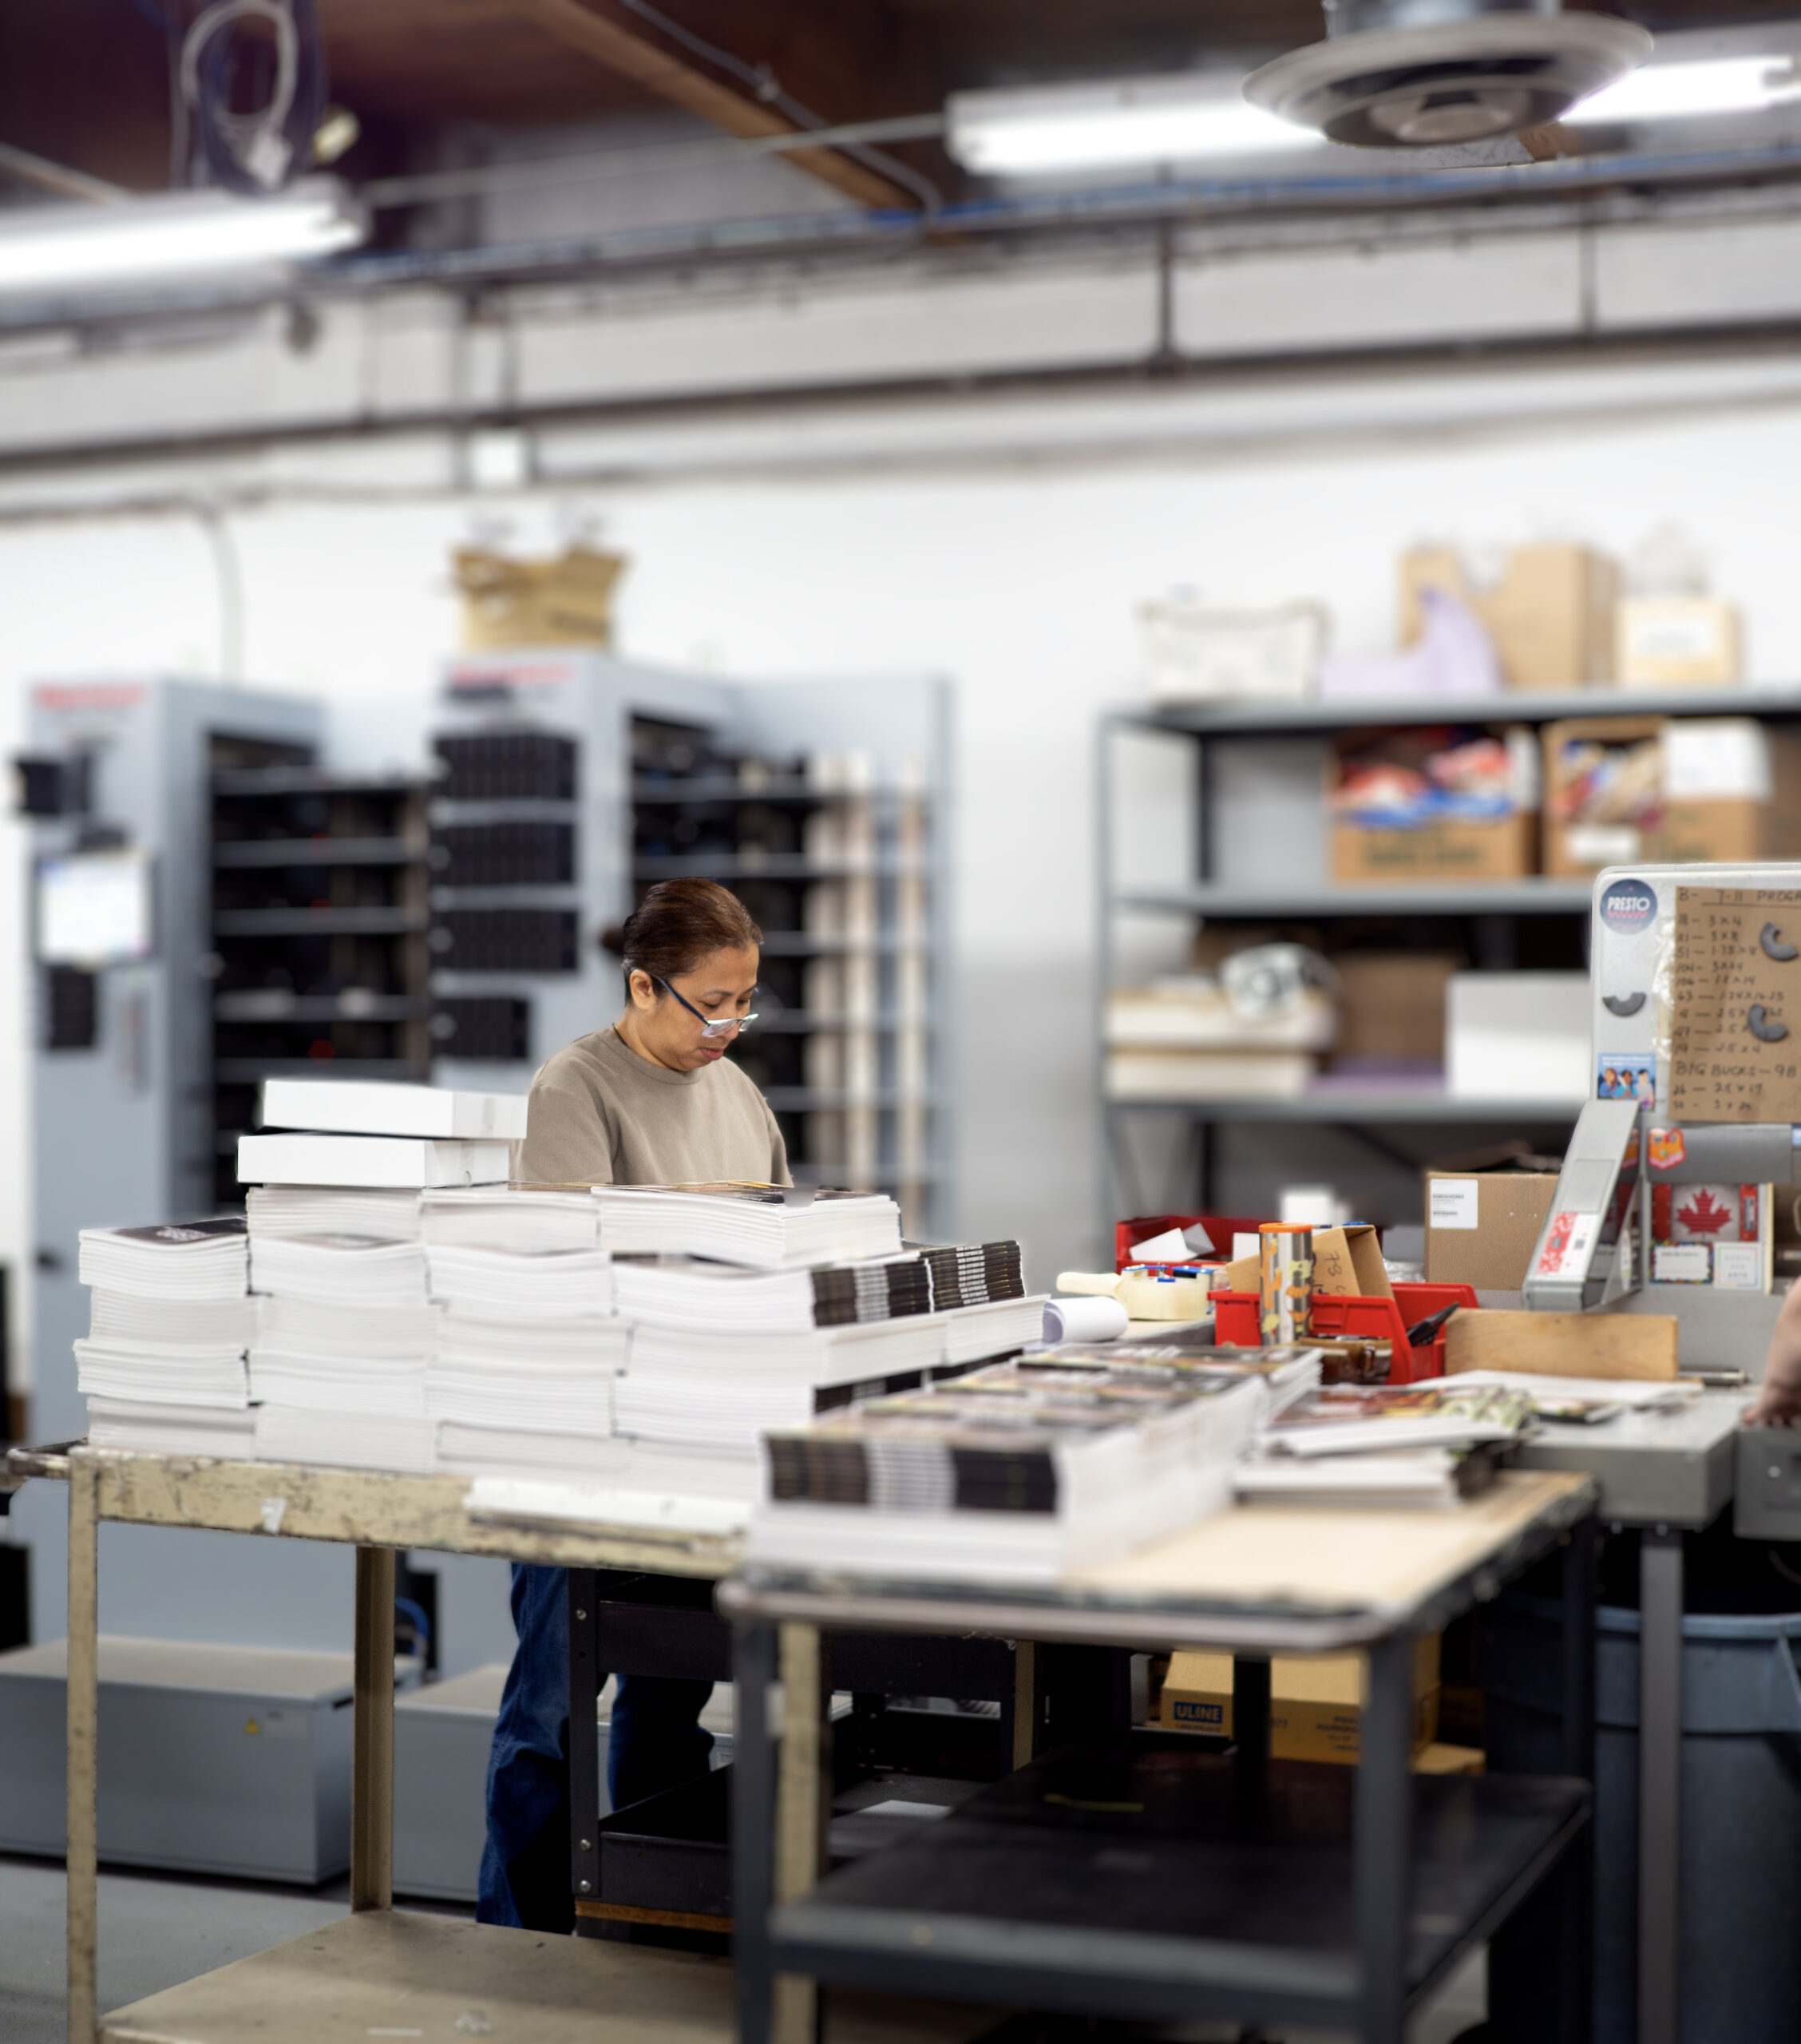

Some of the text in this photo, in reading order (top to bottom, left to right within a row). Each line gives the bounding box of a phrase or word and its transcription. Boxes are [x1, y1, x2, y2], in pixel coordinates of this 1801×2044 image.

[1607, 897, 1650, 911] PRESTO
[1675, 1060, 1706, 1075] BIG
[1176, 1704, 1221, 1721] ULINE
